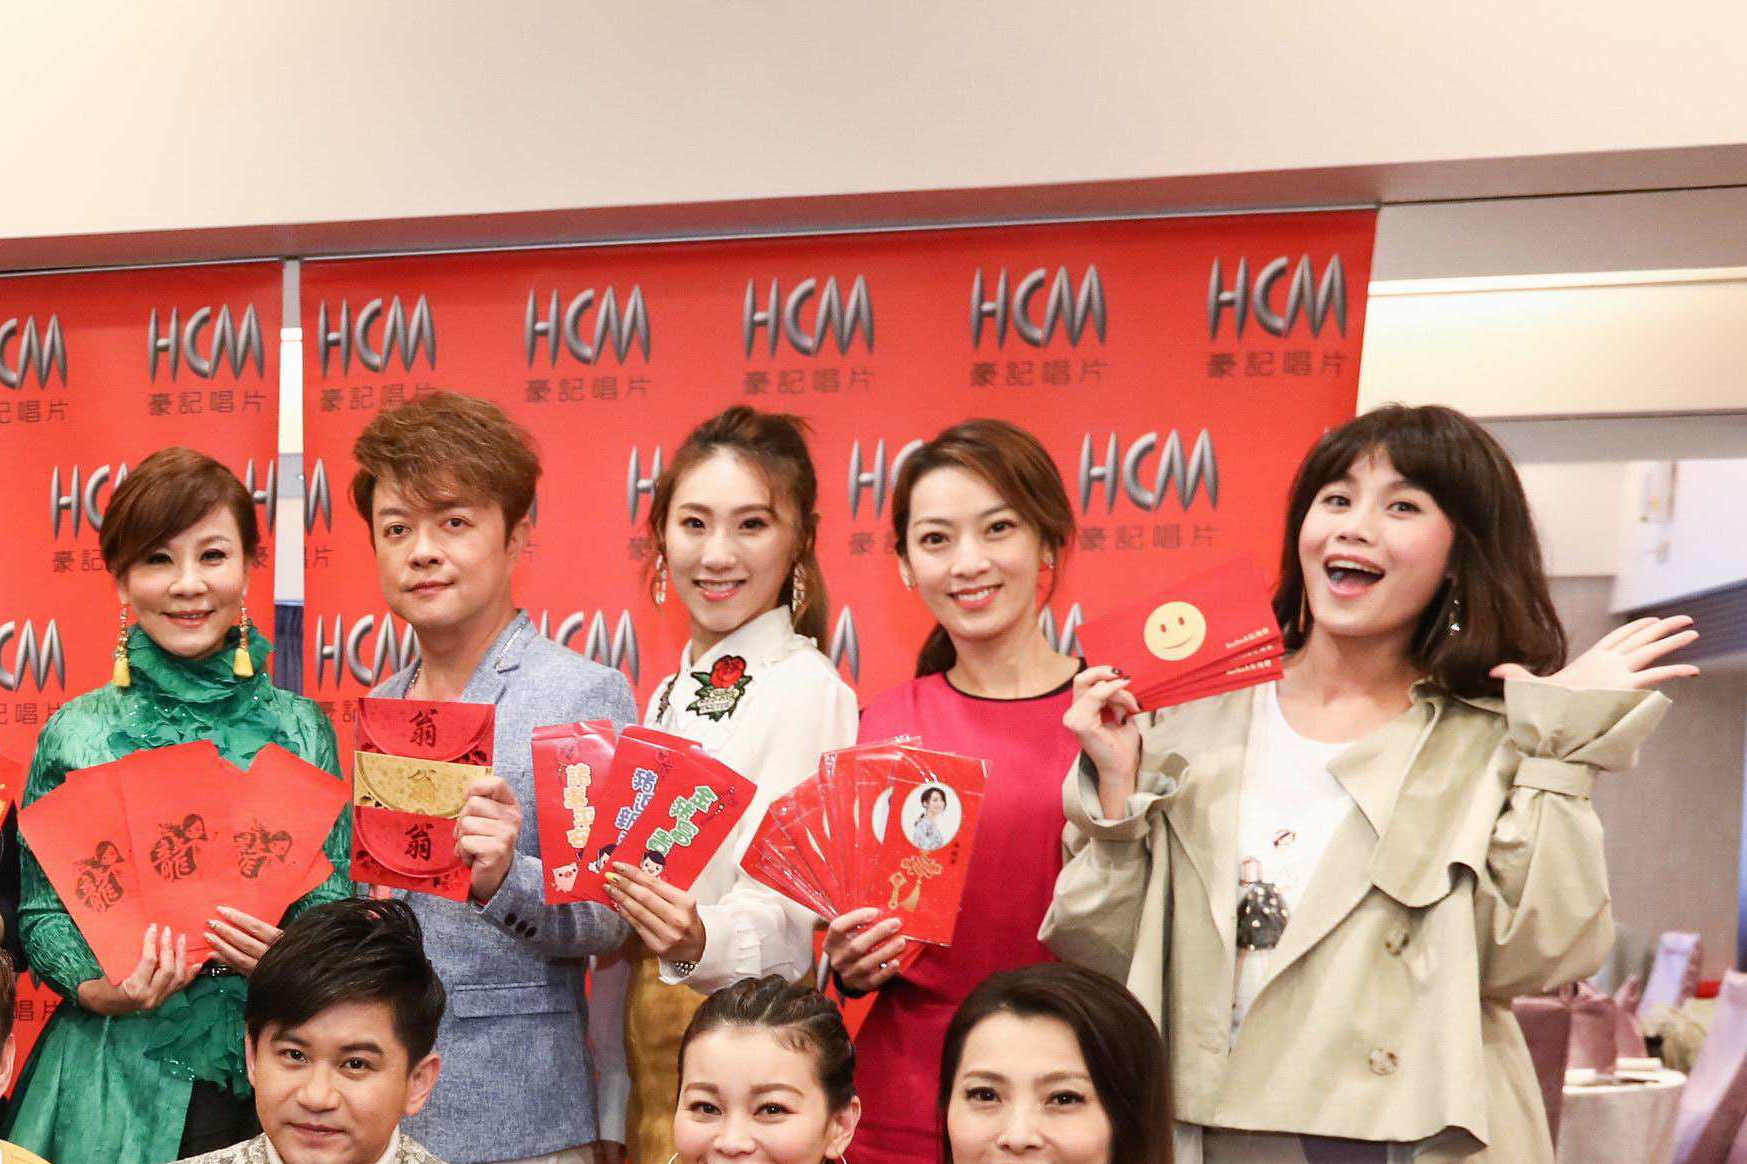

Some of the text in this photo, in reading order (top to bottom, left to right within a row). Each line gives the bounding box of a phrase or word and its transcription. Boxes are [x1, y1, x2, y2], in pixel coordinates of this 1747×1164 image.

[743, 274, 874, 361] HCM
[970, 264, 1107, 351] HCM
[1208, 254, 1347, 340] HCM
[147, 302, 265, 384] HCM
[317, 294, 436, 379] HCM
[524, 284, 651, 369] HCM
[525, 377, 652, 403] 豪記唱片
[743, 368, 874, 396] 豪記唱片
[971, 358, 1107, 387] 豪記唱片
[1207, 349, 1348, 379] 豪記唱片
[148, 390, 266, 417] 豪記唱片
[1079, 428, 1218, 515] HCM
[51, 462, 129, 540] HC
[1079, 524, 1218, 553] 豪記唱片
[410, 709, 438, 748] 翁
[405, 823, 434, 861] 翁
